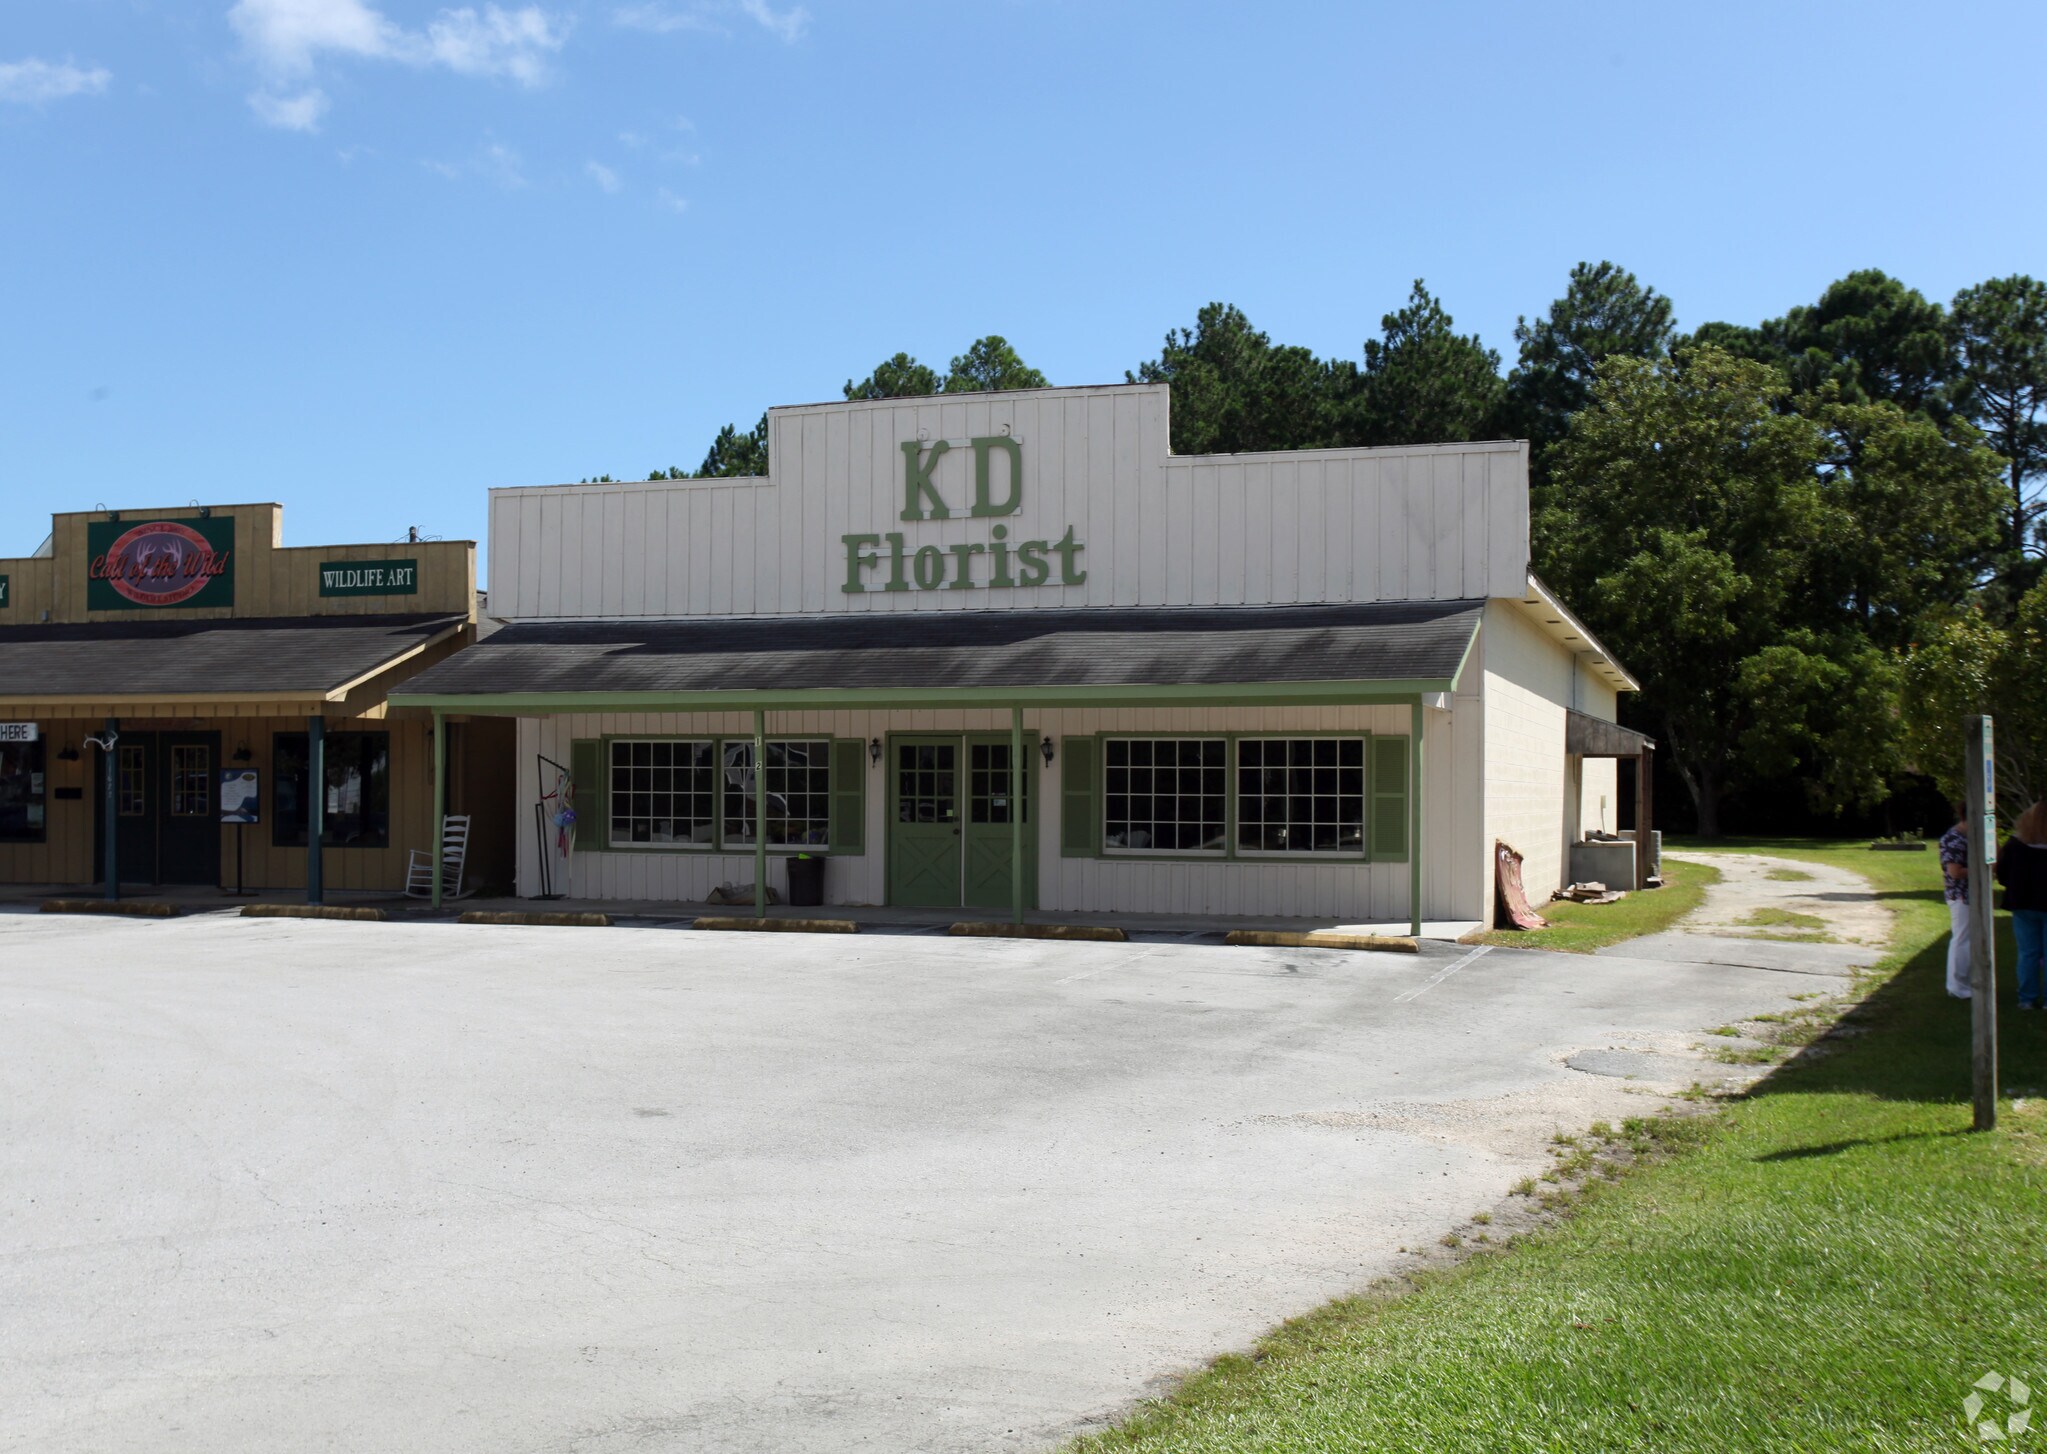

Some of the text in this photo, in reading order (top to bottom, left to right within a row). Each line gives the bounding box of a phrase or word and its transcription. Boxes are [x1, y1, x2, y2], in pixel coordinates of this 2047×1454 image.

[89, 550, 230, 586] Call of the Wild
[841, 524, 1087, 593] Florist
[323, 568, 413, 588] WILDLIFE ART
[0, 724, 28, 740] HERE
